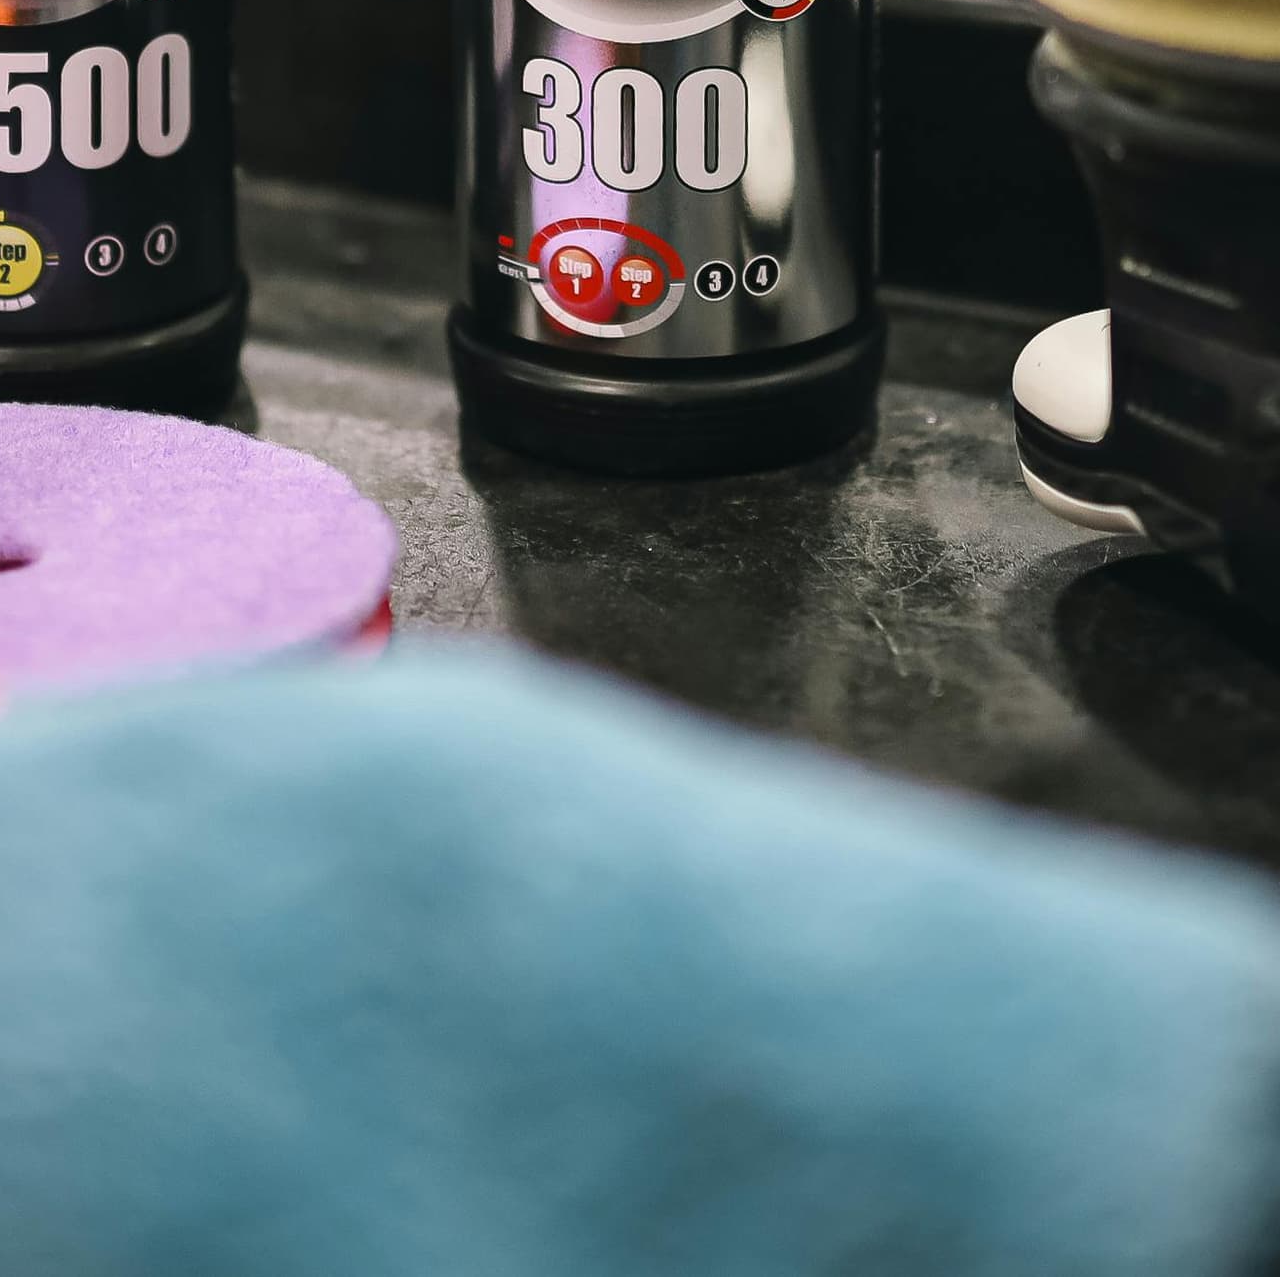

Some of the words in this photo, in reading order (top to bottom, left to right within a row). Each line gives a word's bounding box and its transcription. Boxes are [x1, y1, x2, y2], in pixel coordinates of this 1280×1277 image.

[522, 57, 748, 192] 300
[98, 244, 112, 267] 3
[0, 264, 11, 285] 2
[558, 256, 592, 279] Step
[620, 265, 653, 284] Step
[756, 265, 768, 287] 4
[572, 277, 580, 295] 1
[631, 284, 641, 299] 2
[709, 271, 722, 292] 3
